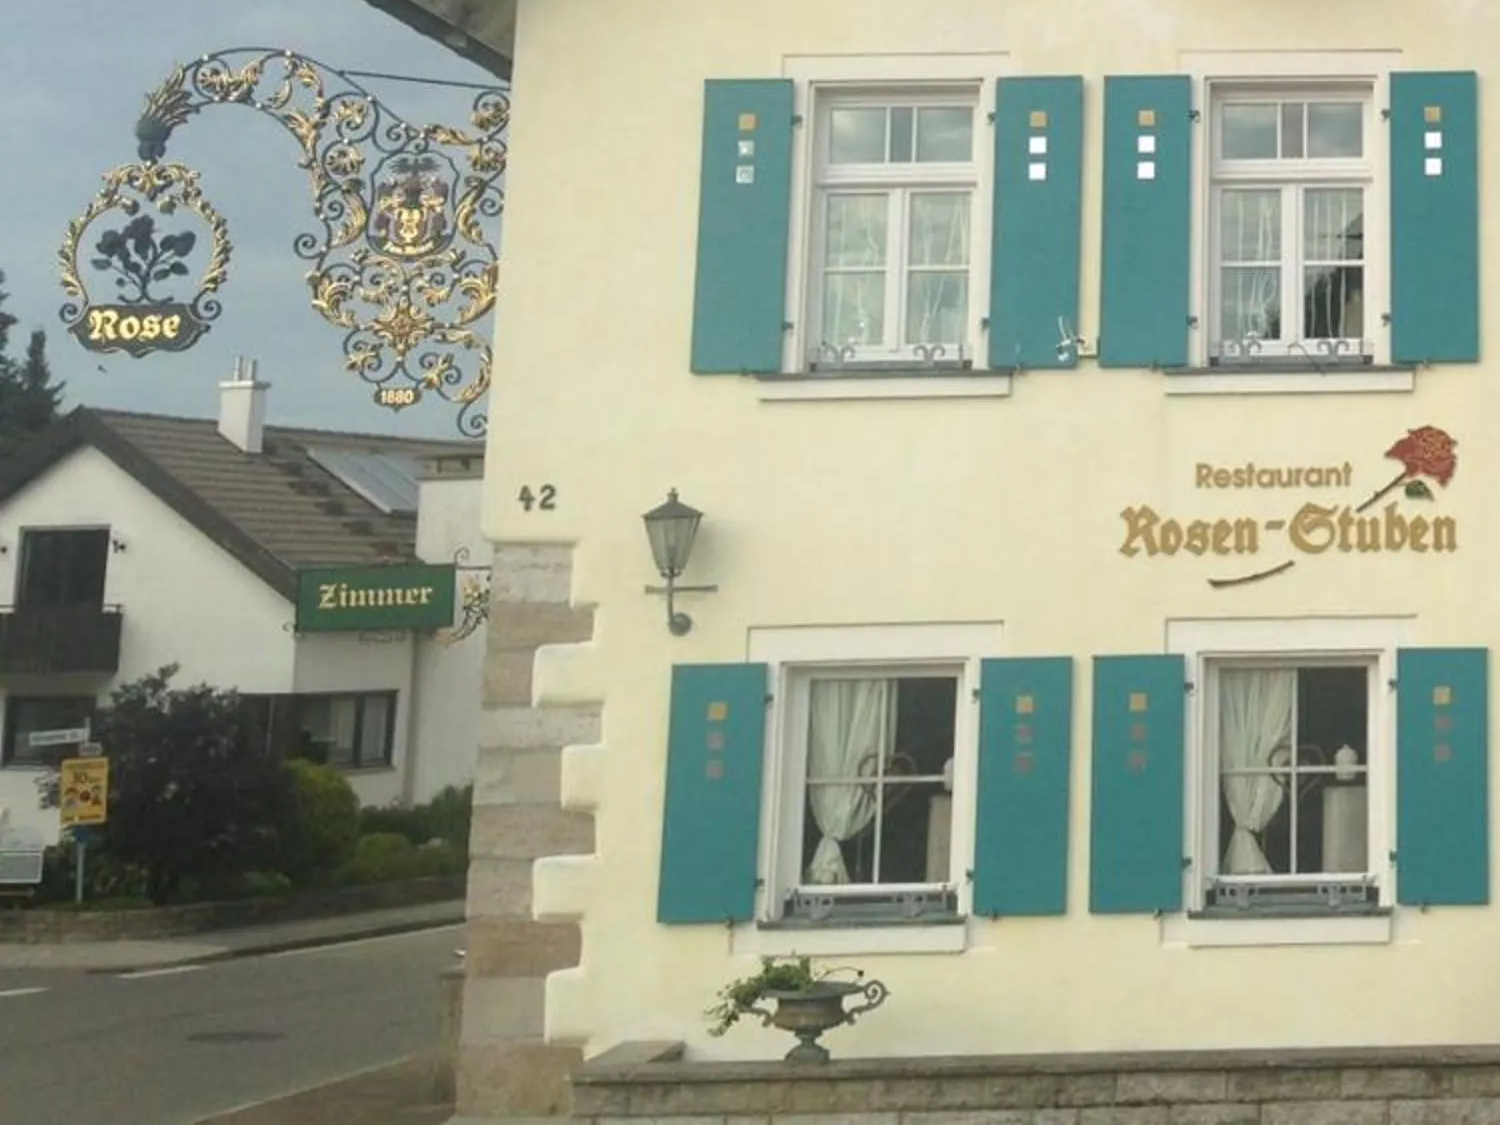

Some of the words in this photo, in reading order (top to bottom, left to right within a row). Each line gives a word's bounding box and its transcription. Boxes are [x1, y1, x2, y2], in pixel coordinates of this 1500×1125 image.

[88, 309, 181, 341] Rose
[1195, 462, 1353, 489] Restaurant
[518, 483, 556, 512] 42
[1118, 501, 1459, 557] Rosen-Stuben
[318, 583, 433, 609] Zimmer
